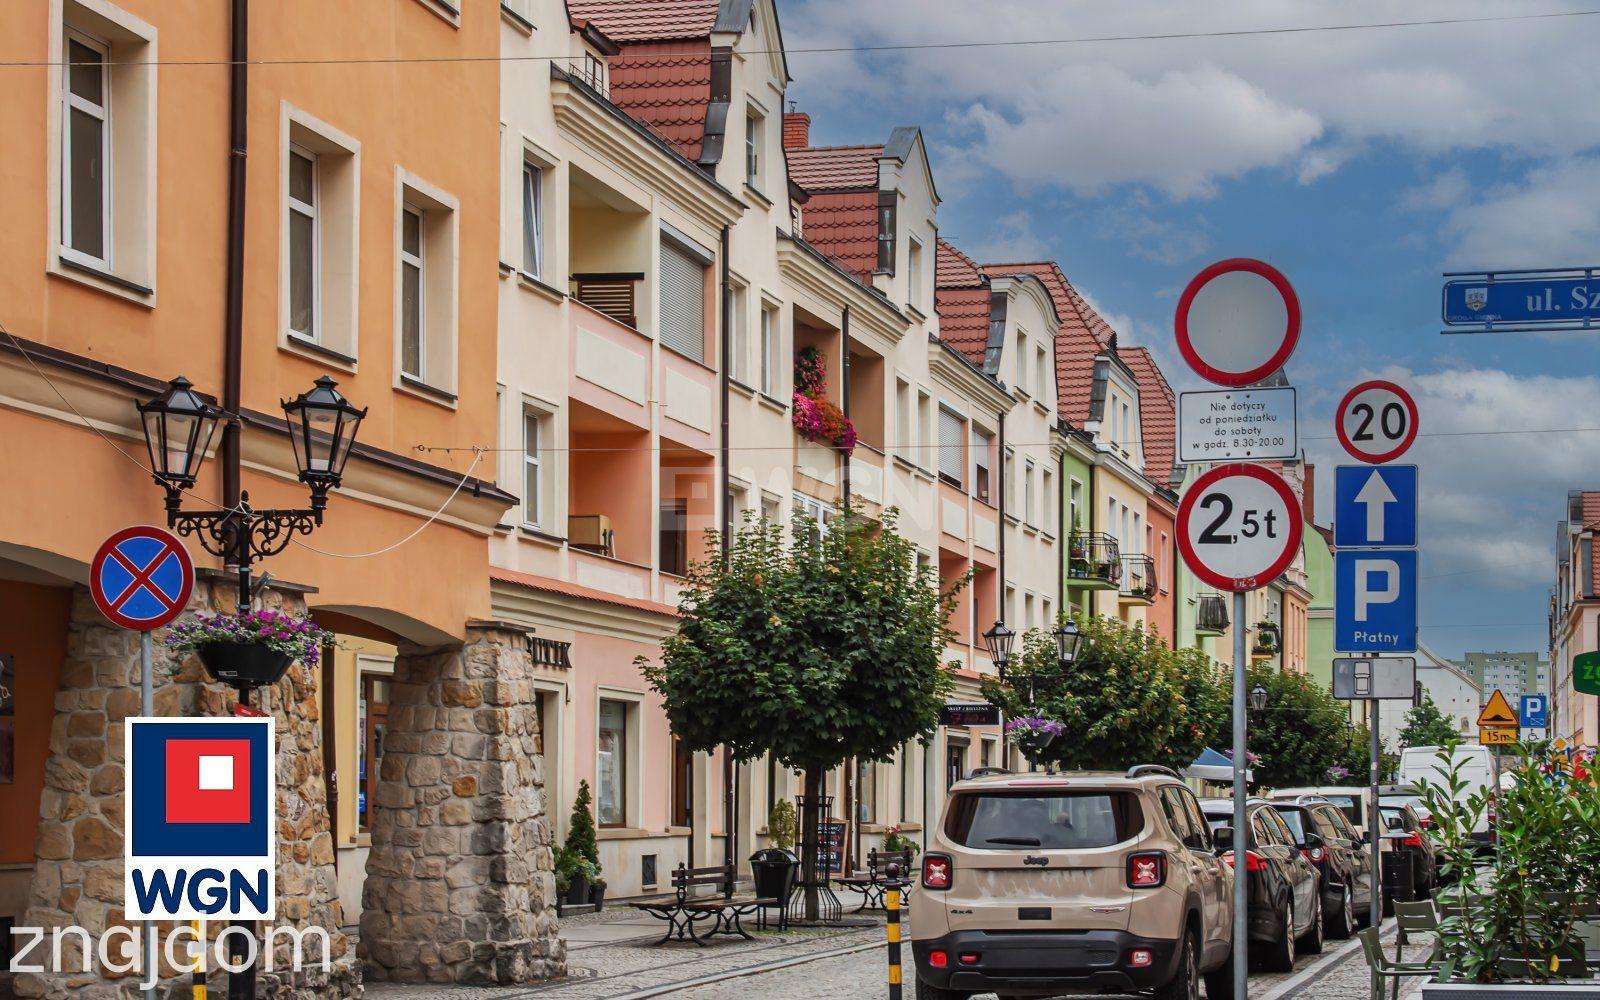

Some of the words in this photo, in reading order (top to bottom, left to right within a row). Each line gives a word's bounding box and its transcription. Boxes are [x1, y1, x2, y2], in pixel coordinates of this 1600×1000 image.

[1526, 288, 1561, 312] ul.
[1210, 402, 1227, 412] Nie
[1230, 401, 1266, 412] dotyczy
[1199, 415, 1212, 425] od
[1215, 414, 1277, 426] poniedziałku
[1352, 401, 1407, 441] 20
[1214, 427, 1227, 437] do
[1230, 426, 1262, 438] soboty
[1192, 442, 1200, 450] w
[1203, 439, 1229, 452] godz.
[1233, 437, 1284, 449] 8.30-20.00
[1354, 559, 1400, 622] P
[1354, 631, 1399, 645] Płatny
[1526, 698, 1541, 718] P
